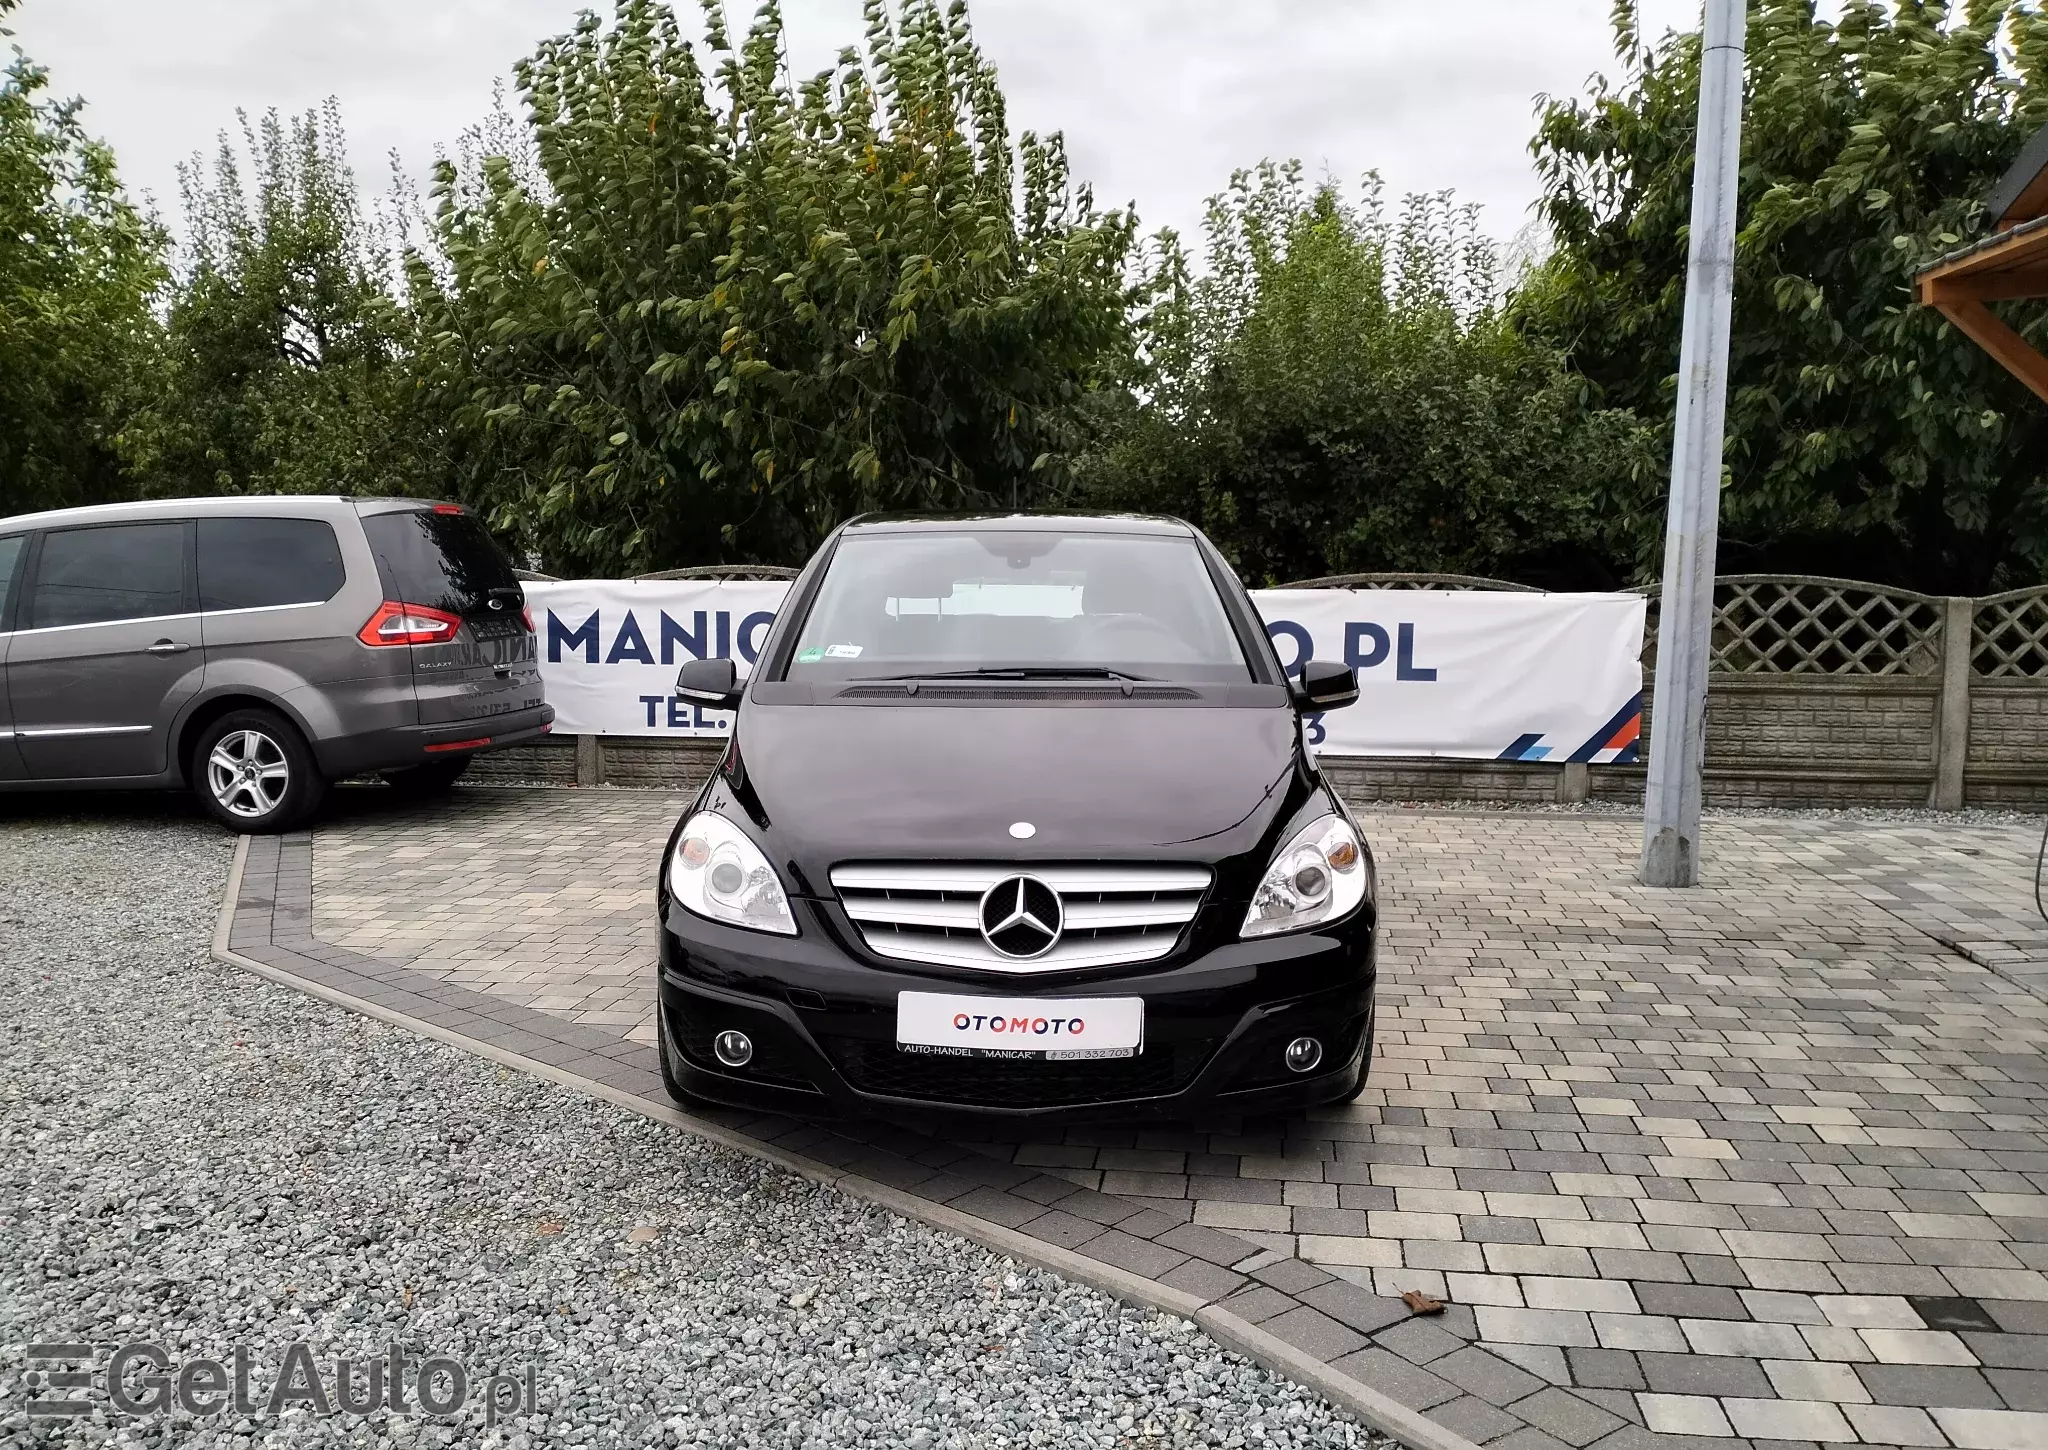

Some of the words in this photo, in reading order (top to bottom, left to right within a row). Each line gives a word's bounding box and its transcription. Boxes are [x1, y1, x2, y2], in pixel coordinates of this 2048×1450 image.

[419, 661, 452, 669] GALAXY
[639, 695, 728, 729] TEL.
[1302, 712, 1327, 746] 3
[953, 1013, 1085, 1035] OTOMOTO
[904, 1044, 974, 1057] AUTO-HANDEL
[981, 1050, 1036, 1059] "MANICAR"
[1060, 1050, 1081, 1059] 501
[1084, 1050, 1106, 1059] 332
[1108, 1048, 1130, 1058] 703
